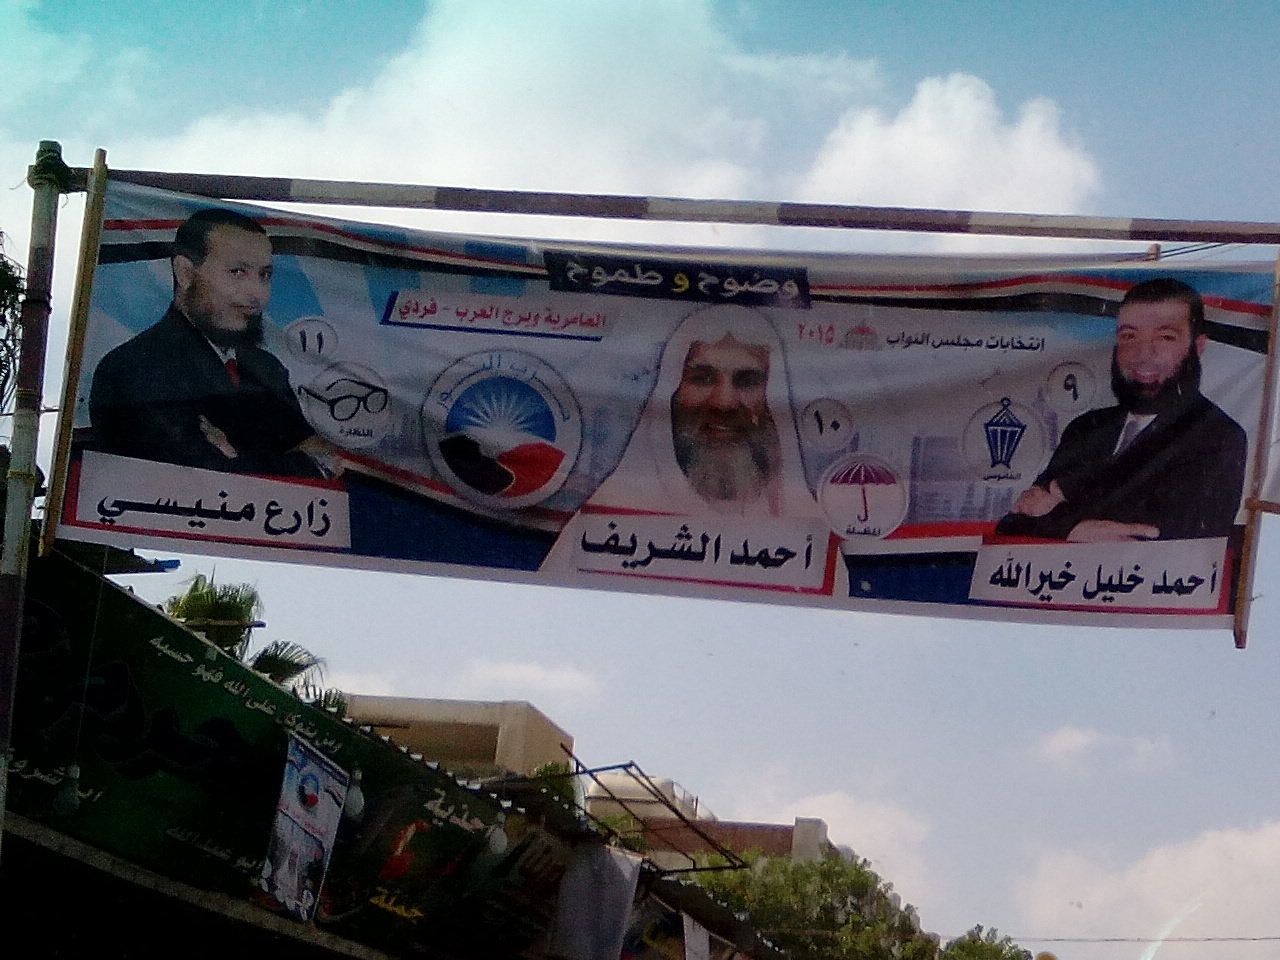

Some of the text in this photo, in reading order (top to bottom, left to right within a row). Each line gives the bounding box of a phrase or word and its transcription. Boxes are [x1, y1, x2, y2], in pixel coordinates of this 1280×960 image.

[566, 261, 800, 298] وضوح و طموح
[456, 303, 499, 320] العرب
[300, 329, 323, 353] ١١
[886, 330, 1046, 352] انتخابات مجلس النواب
[1063, 373, 1079, 401] ٩
[96, 490, 332, 537] زارع منيسي
[580, 520, 813, 570] أحمد الشريف
[1082, 562, 1144, 603] خليل
[1152, 561, 1219, 597] أحمد
